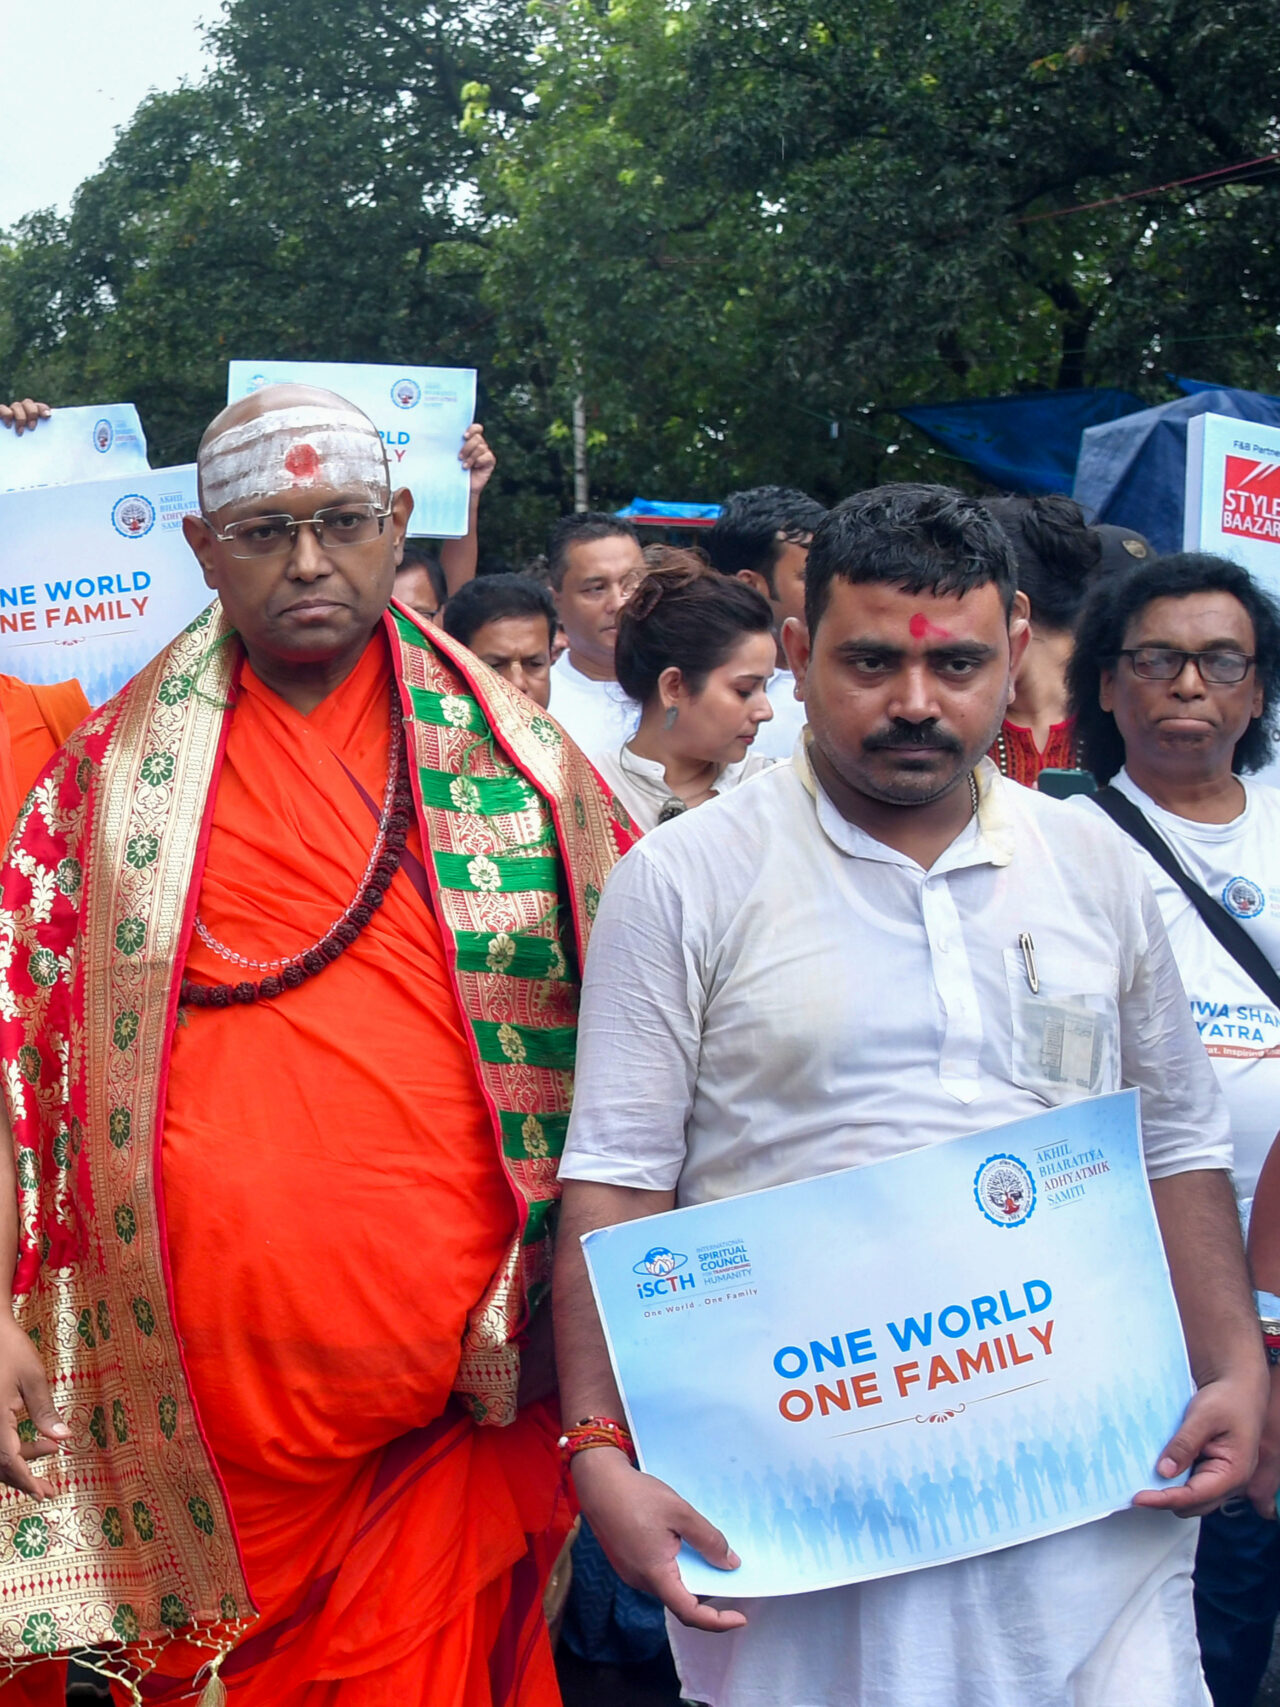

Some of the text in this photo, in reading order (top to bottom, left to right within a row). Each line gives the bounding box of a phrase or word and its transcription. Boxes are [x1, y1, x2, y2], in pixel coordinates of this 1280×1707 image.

[1253, 444, 1280, 457] Partne
[44, 571, 151, 602] WORLD
[45, 596, 149, 628] FAMILY
[1195, 1021, 1264, 1043] YATRA
[1036, 1143, 1073, 1164] AKHIL
[1038, 1148, 1105, 1178] BHARATIYA
[1043, 1160, 1111, 1192] ADHYATMIK
[1046, 1183, 1086, 1206] SAMITI
[698, 1244, 748, 1262] SPIRITUAL
[700, 1253, 750, 1272] COUNCIL
[636, 1272, 696, 1300] iSCTH
[703, 1268, 753, 1286] HUMANITY
[644, 1288, 759, 1318] One World One Family
[773, 1279, 1053, 1379] ONE WORLD
[778, 1319, 1055, 1423] ONE FAMILY
